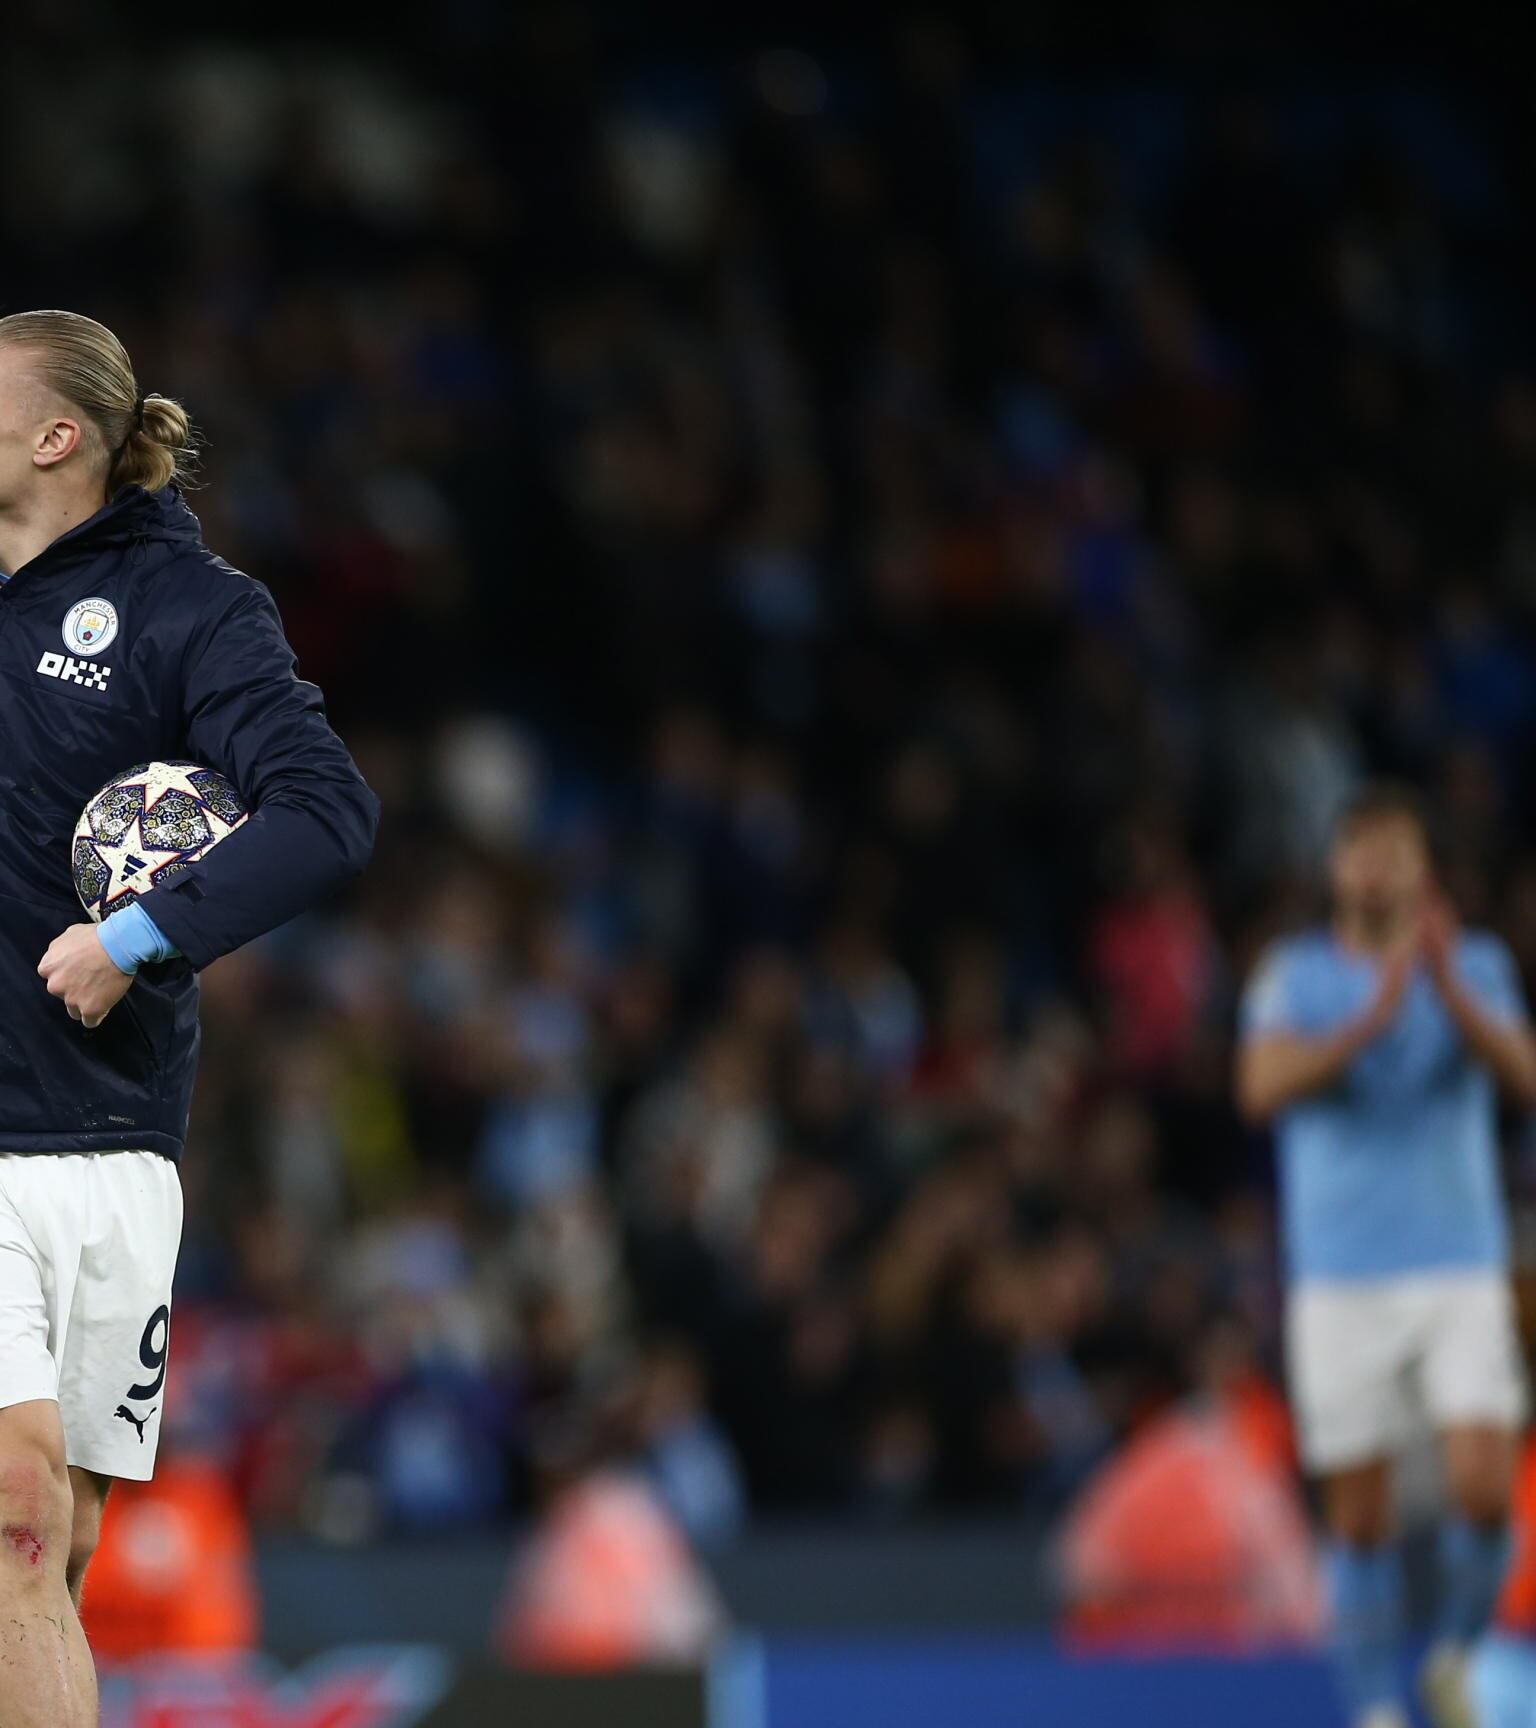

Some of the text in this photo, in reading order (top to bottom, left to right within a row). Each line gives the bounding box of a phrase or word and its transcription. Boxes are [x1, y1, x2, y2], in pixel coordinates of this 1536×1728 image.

[74, 601, 116, 626] MANCHESTER
[73, 645, 90, 653] CITY
[36, 651, 111, 691] OKX
[126, 1304, 169, 1400] 9
